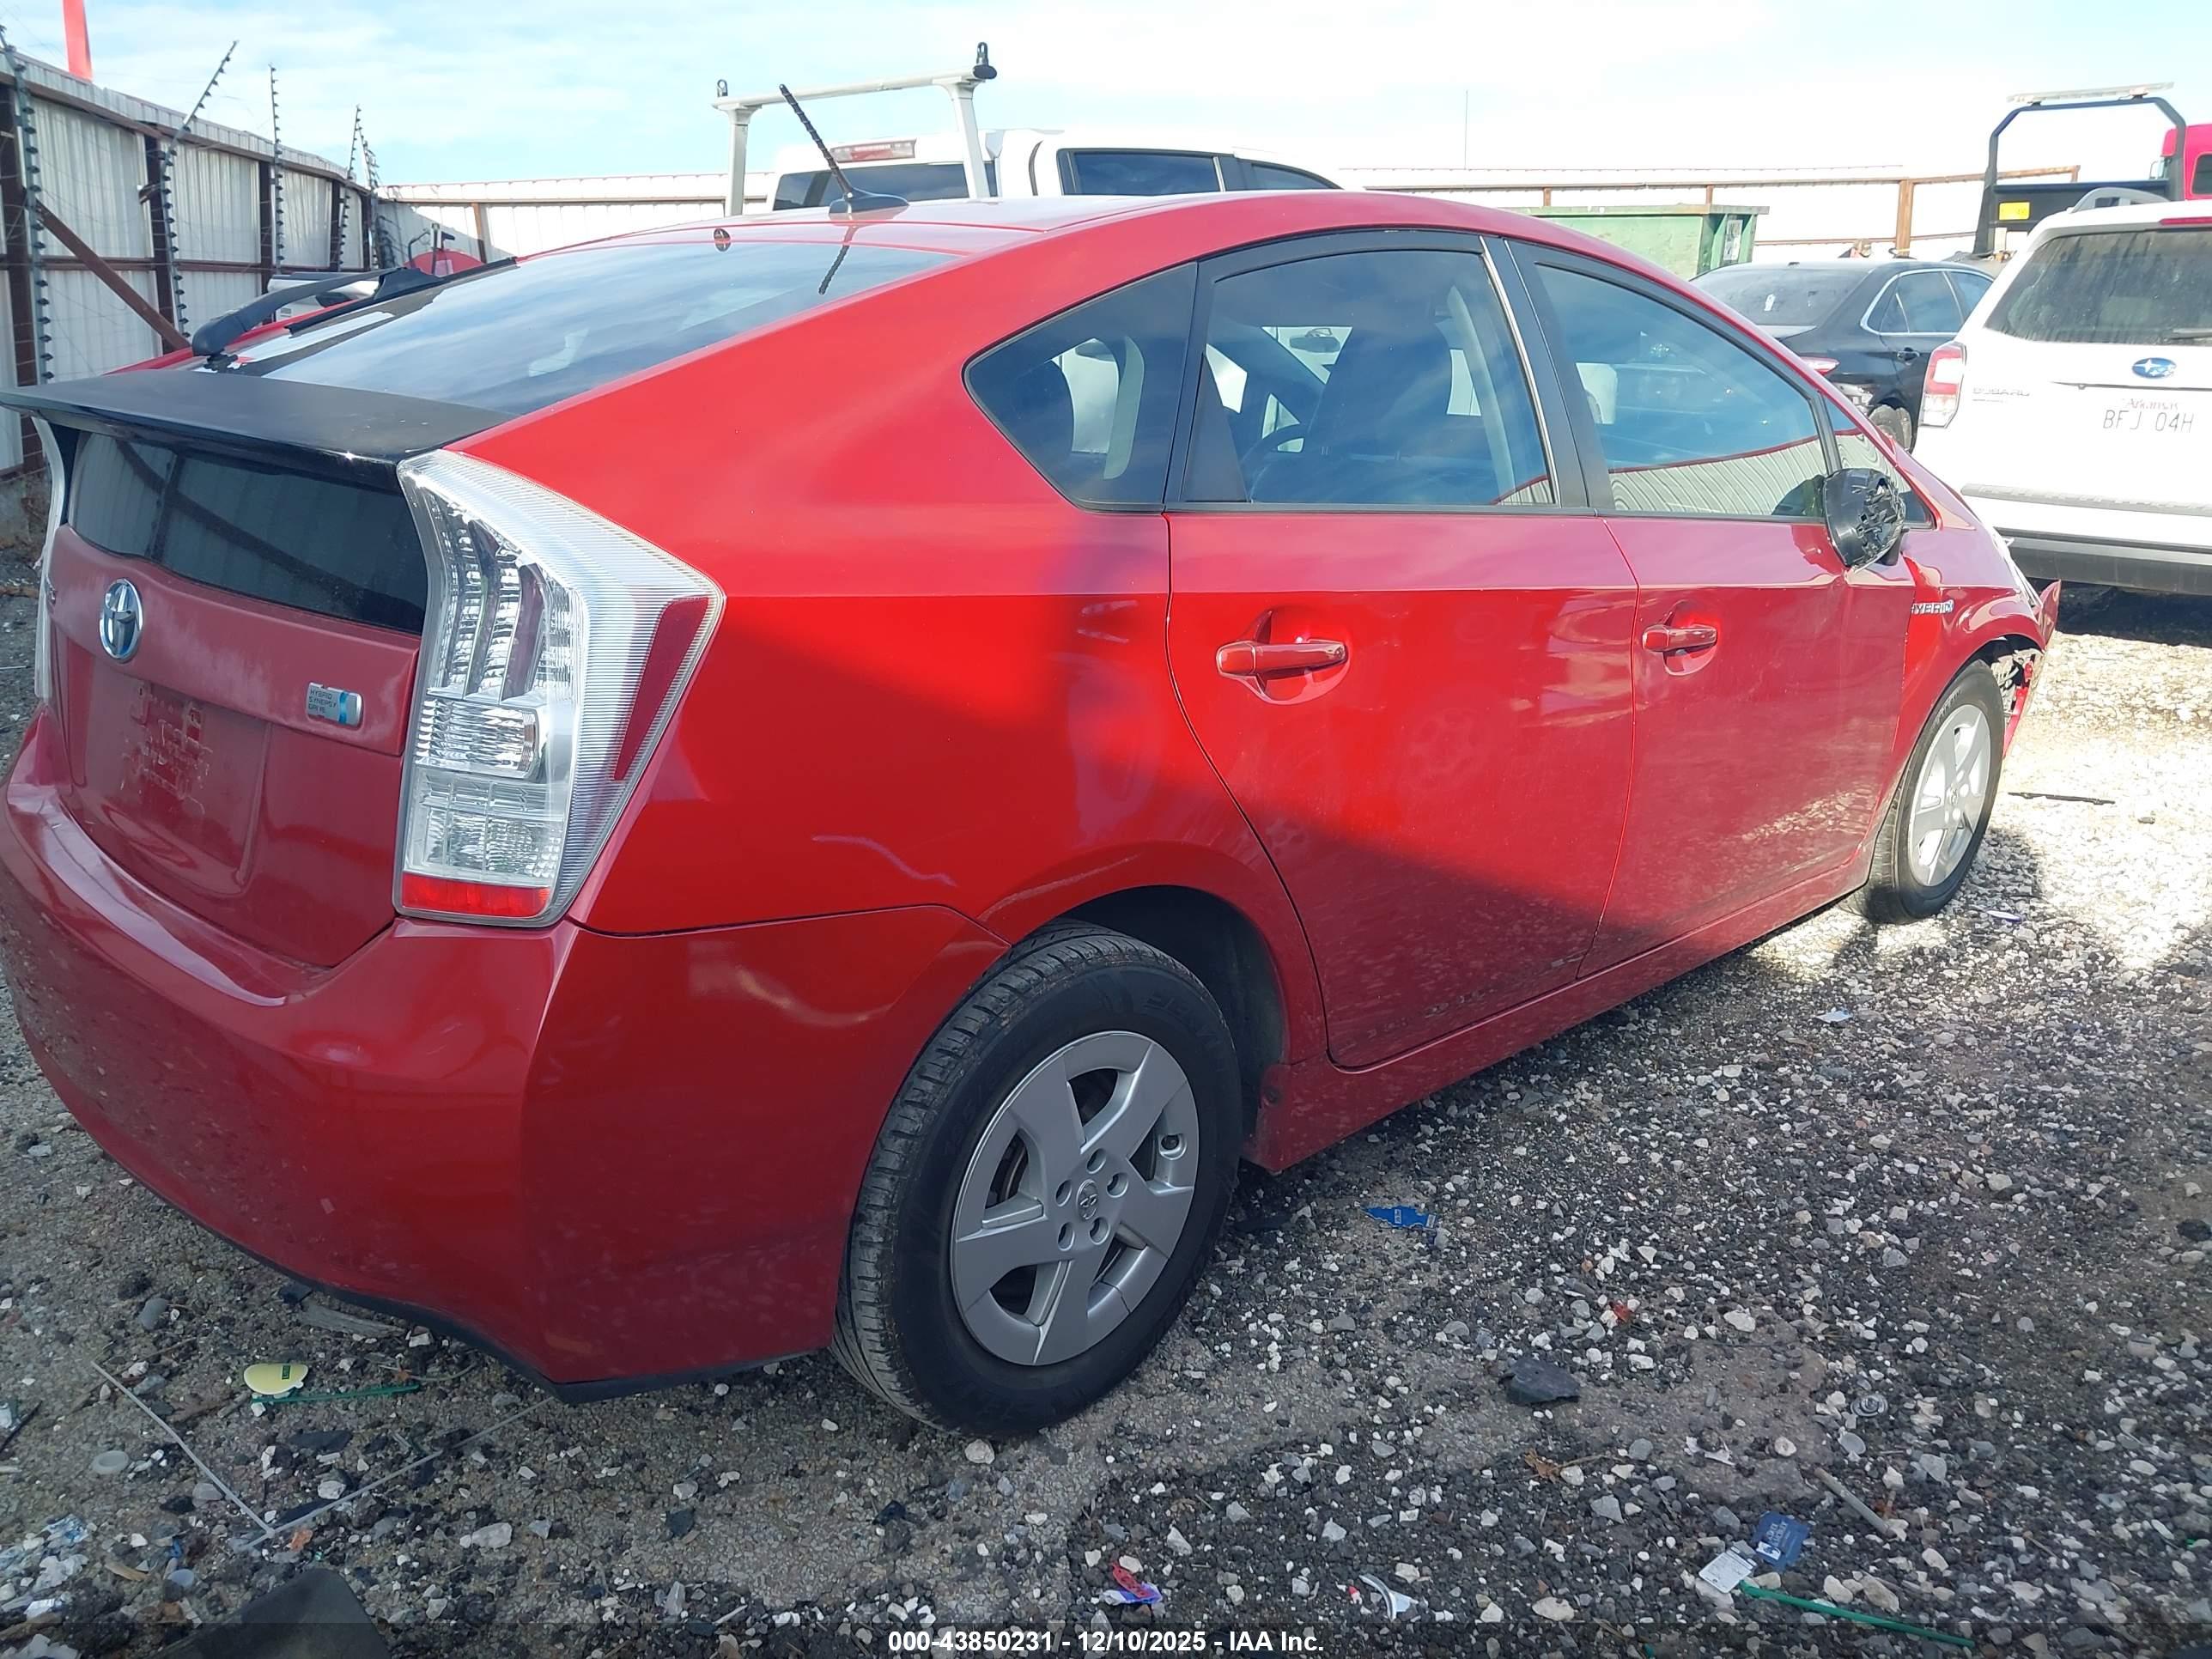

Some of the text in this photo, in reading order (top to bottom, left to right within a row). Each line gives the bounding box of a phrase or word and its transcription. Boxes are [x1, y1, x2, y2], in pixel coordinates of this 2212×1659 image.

[2103, 410, 2195, 433] BFJ 04H
[310, 689, 332, 700] HYBRID
[309, 696, 337, 708] SYNERGY
[309, 704, 326, 714] DRIVE
